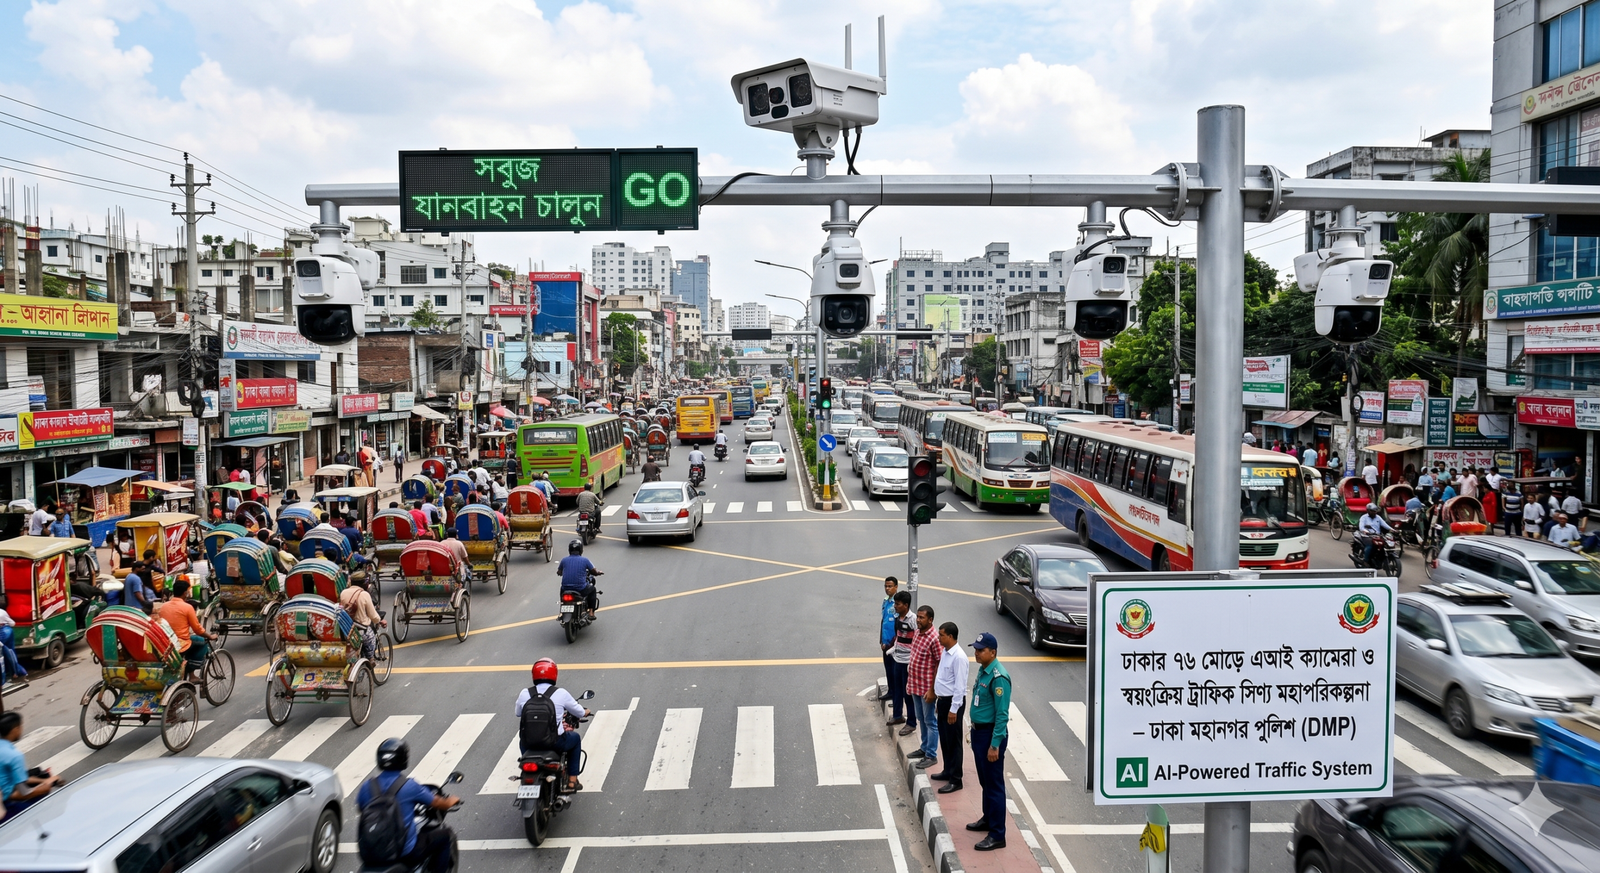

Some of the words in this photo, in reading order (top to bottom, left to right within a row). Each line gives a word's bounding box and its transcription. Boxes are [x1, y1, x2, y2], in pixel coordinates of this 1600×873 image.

[474, 158, 541, 189] সবুজ
[624, 172, 690, 207] GO
[411, 191, 527, 223] যানবাহন
[533, 190, 604, 227] চালুন
[1120, 650, 1167, 671] ঢাকার
[1173, 652, 1196, 671] ৭৬
[1201, 648, 1246, 673] মোড়ে
[1250, 644, 1295, 669] এআই
[1298, 646, 1357, 669] ক্যামেরা
[1361, 649, 1375, 666] ও
[1120, 681, 1184, 707] স্বয়ংক্রিয়
[1186, 679, 1236, 708] ট্রাফিক
[1275, 679, 1372, 704] মহাপরিকল্পনা
[1148, 719, 1185, 742] ঢাকা
[1188, 718, 1250, 743] মহানগর
[1254, 714, 1297, 744] পুলিশ
[1301, 716, 1357, 743] (DMP)
[1120, 763, 1144, 782] AI
[1153, 763, 1250, 781] AI-Powered
[1254, 761, 1307, 779] Traffic
[1311, 760, 1373, 780] System
